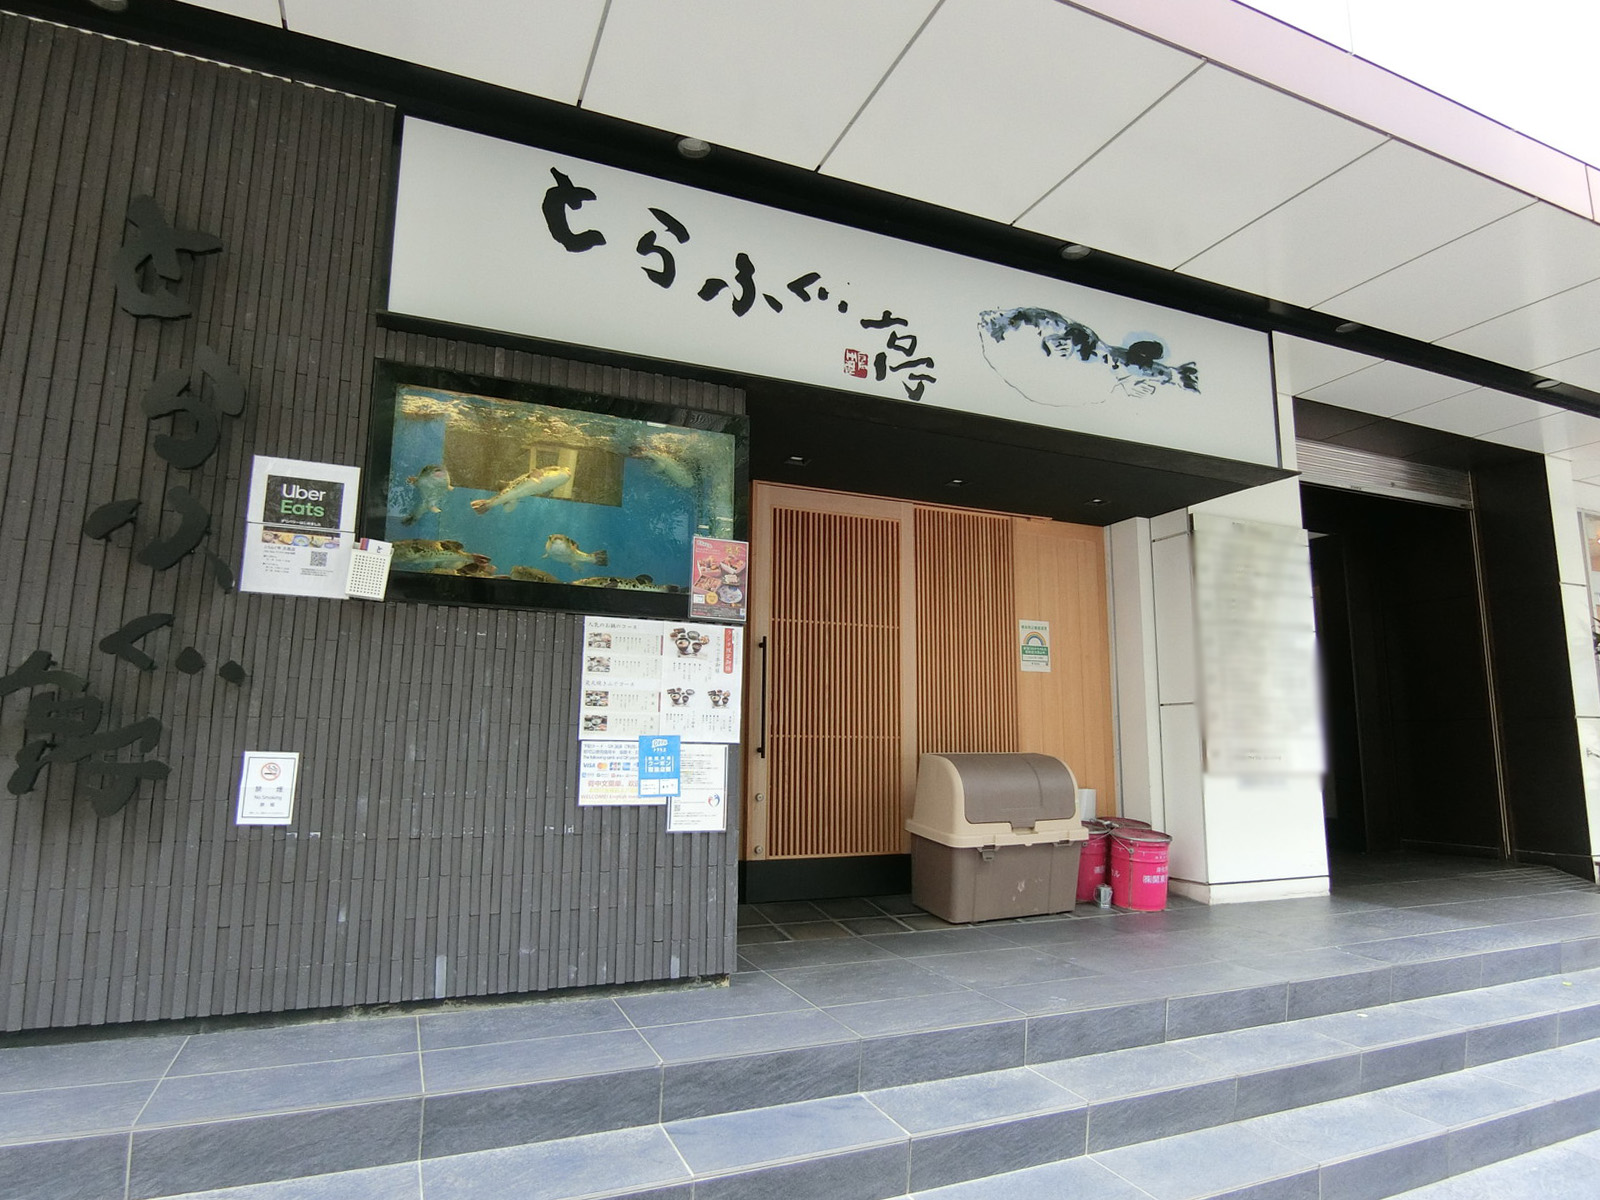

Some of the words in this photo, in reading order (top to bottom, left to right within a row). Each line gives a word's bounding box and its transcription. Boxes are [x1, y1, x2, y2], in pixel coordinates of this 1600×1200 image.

[541, 166, 939, 402] とらふぐ亭
[283, 484, 326, 502] Uber
[281, 500, 324, 517] Eats
